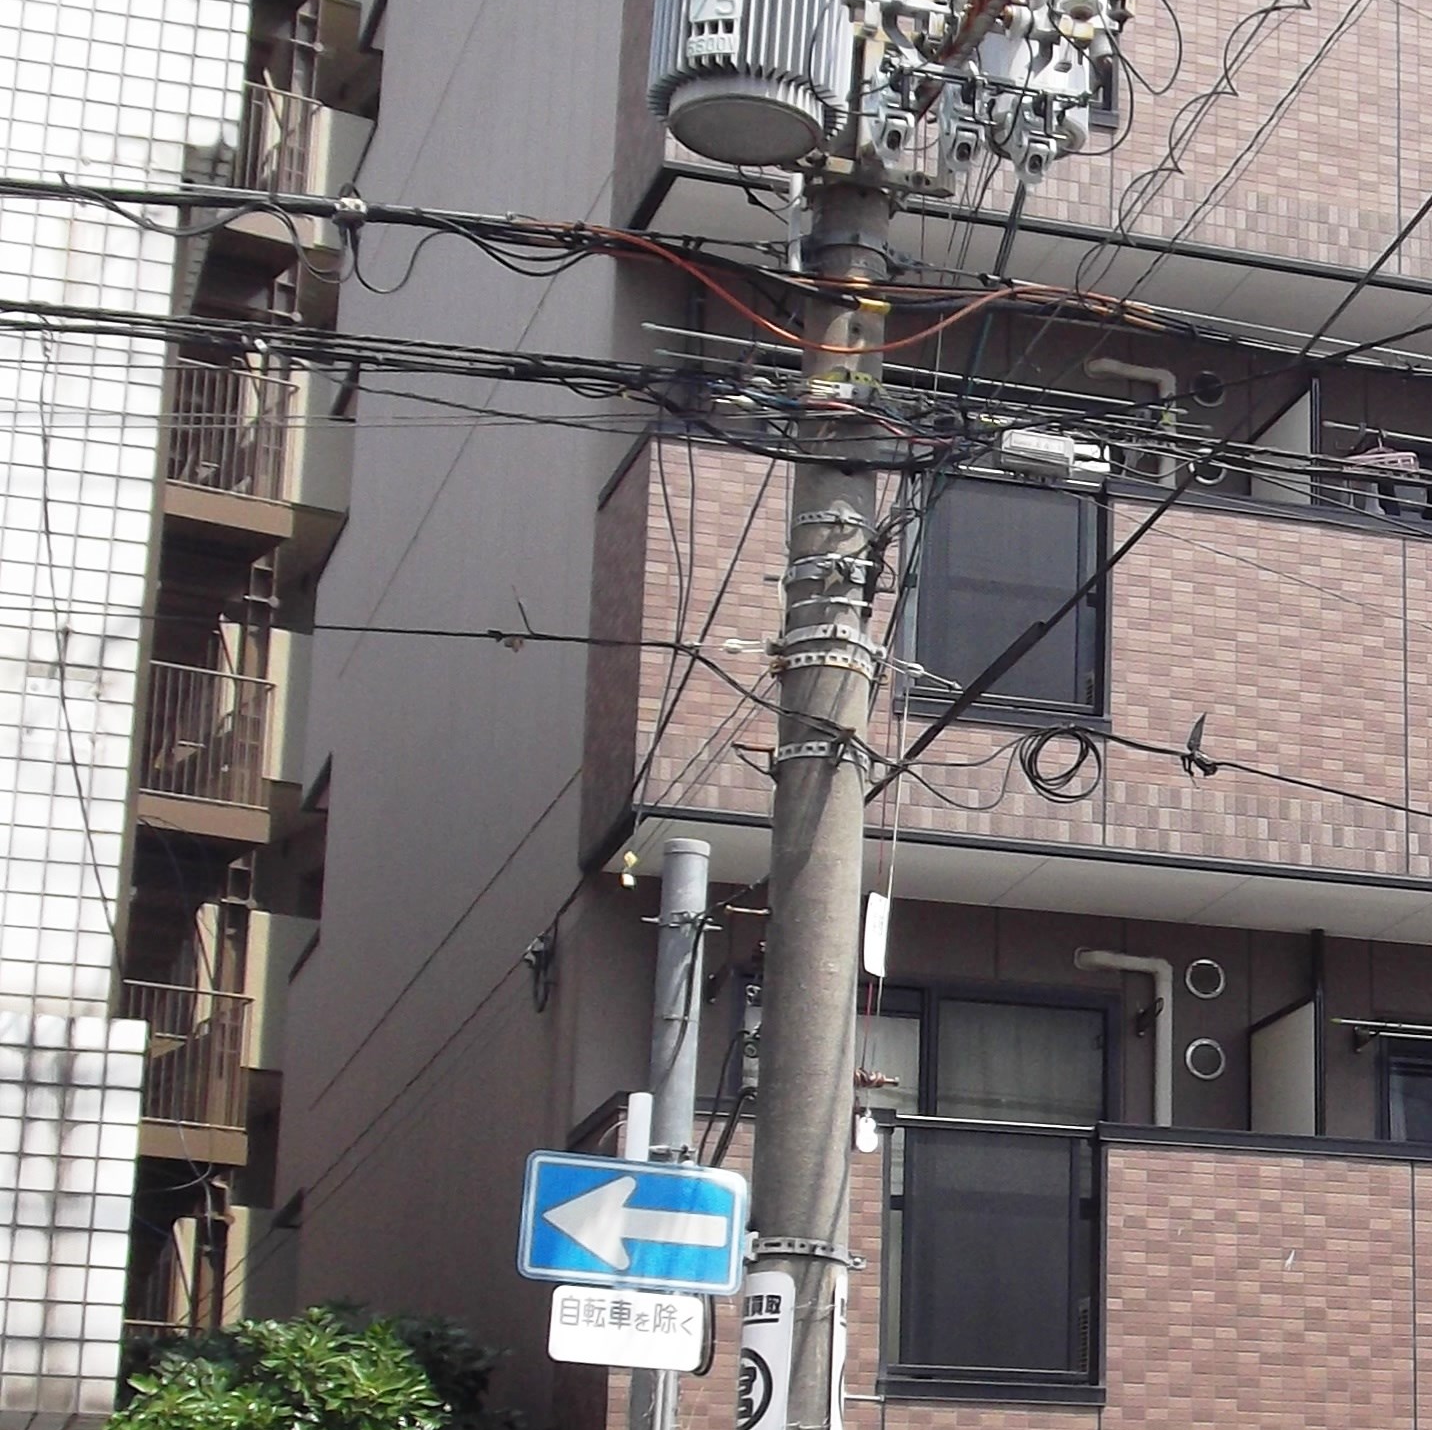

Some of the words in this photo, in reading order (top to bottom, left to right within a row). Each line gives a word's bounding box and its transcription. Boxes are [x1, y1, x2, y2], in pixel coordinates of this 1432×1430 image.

[560, 1295, 694, 1336] 自転車を除く
[744, 1294, 782, 1317] 買取
